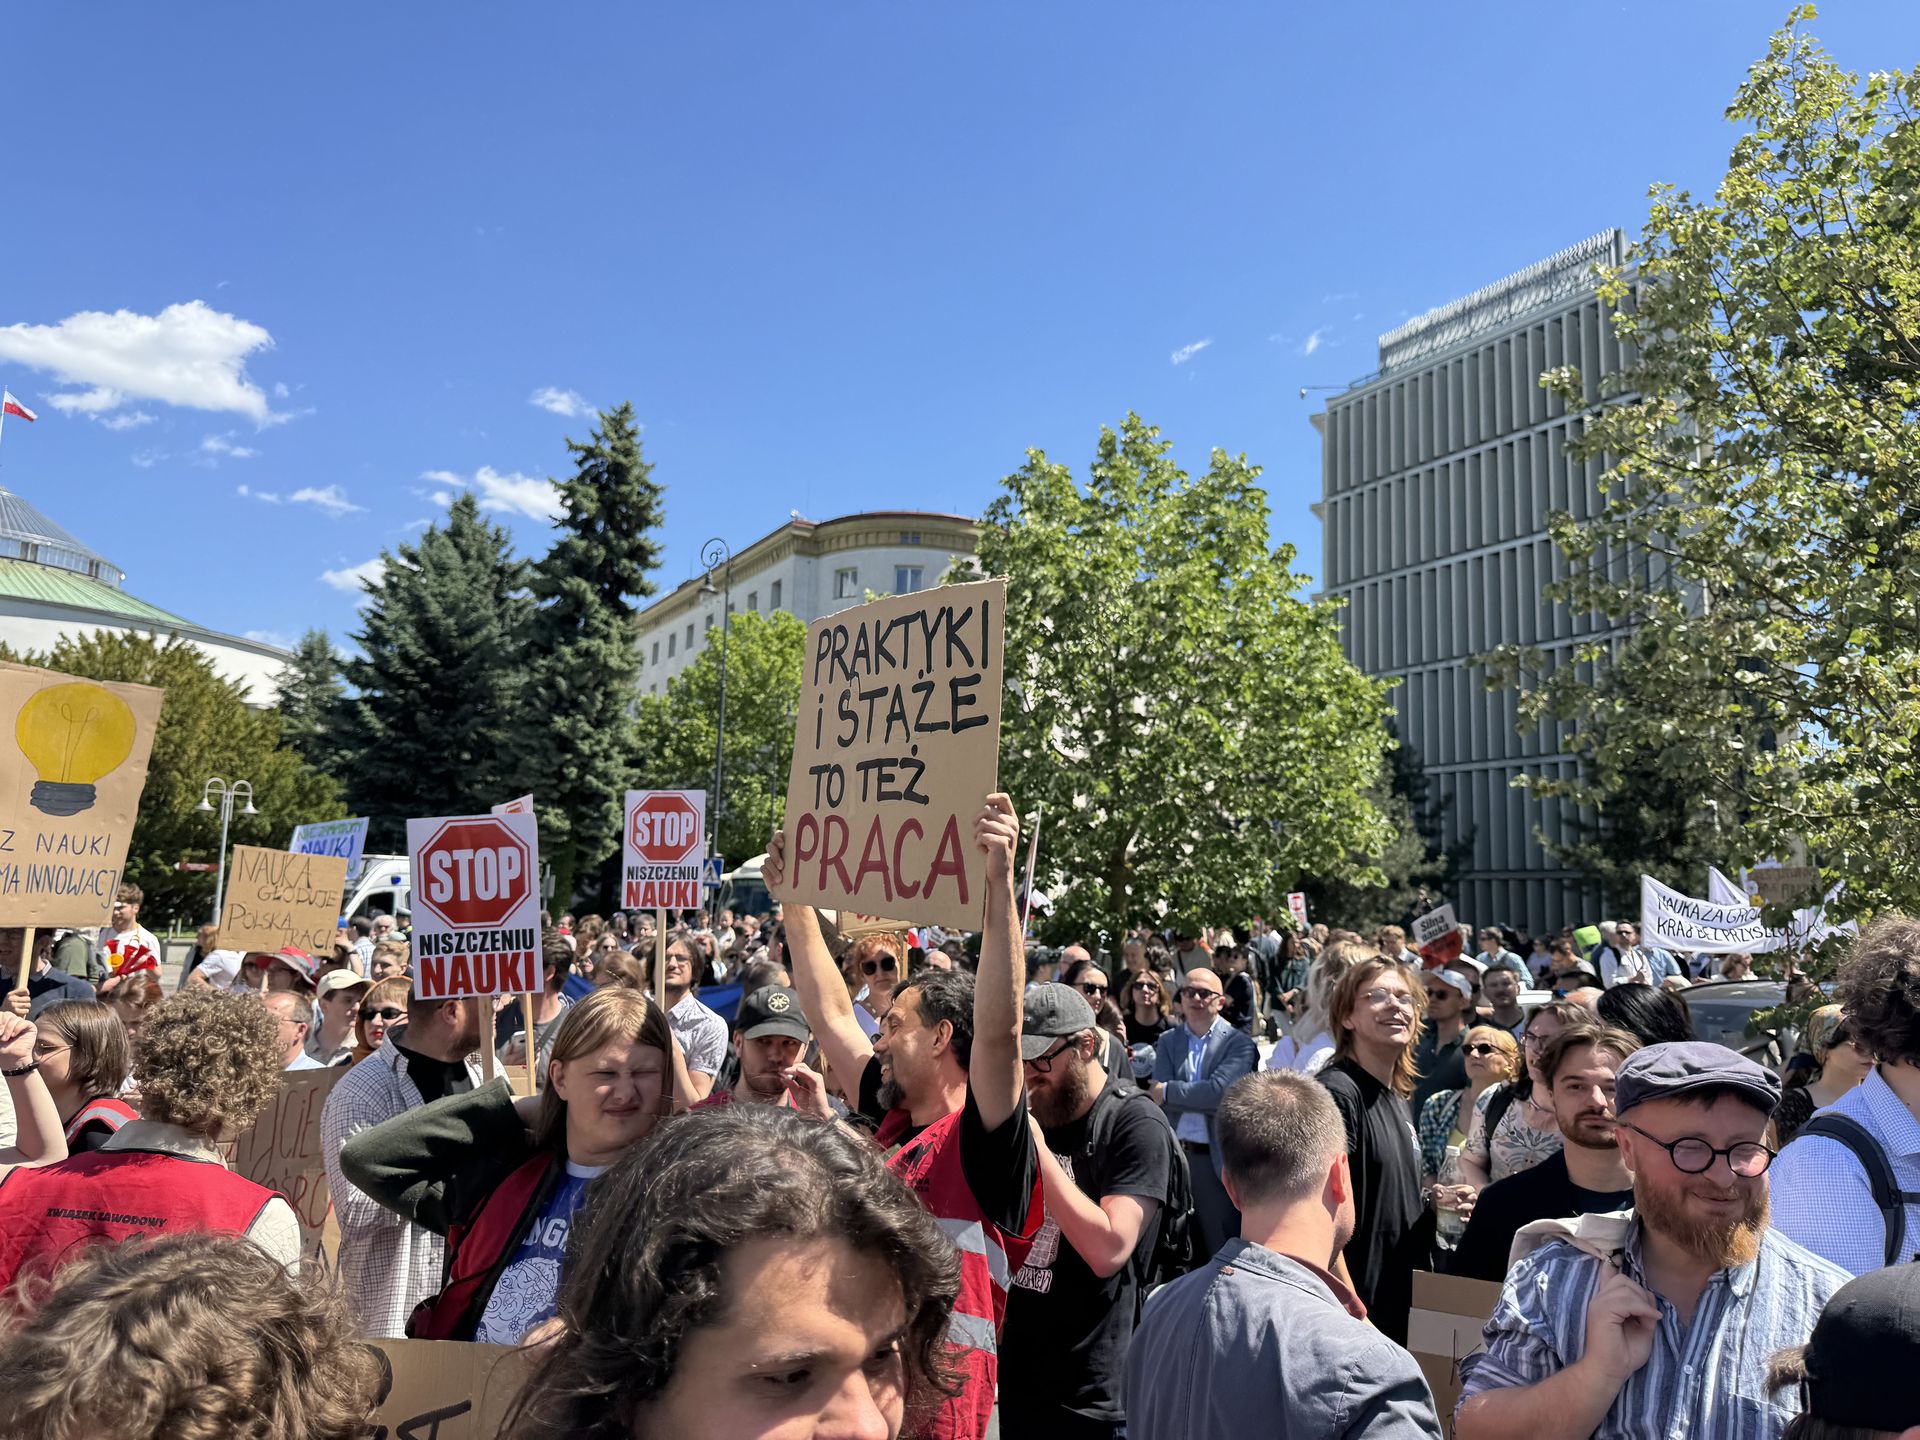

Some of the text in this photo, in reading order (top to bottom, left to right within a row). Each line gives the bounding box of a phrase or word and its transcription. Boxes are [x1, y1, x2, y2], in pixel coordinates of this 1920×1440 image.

[814, 600, 989, 686] PRAKTYKI
[837, 669, 989, 748] STAŻE
[809, 744, 930, 810] TO TEŻ
[36, 832, 111, 857] NAUKI
[635, 811, 694, 848] STOP
[238, 850, 312, 889] NAUKA
[430, 846, 521, 903] STOP
[627, 865, 699, 881] NISZCZENIU
[793, 812, 969, 905] PRACA
[25, 863, 122, 909] INNOWACJI
[257, 885, 338, 908] GŁODUJE
[626, 881, 698, 908] NAUKI
[228, 903, 293, 931] POLSKA
[1420, 915, 1445, 932] Silna
[1657, 892, 1762, 924] NAUKA ZA GRO
[419, 928, 536, 957] NISZCZENIU
[1421, 923, 1450, 942] nauka
[420, 951, 536, 997] NAUKI
